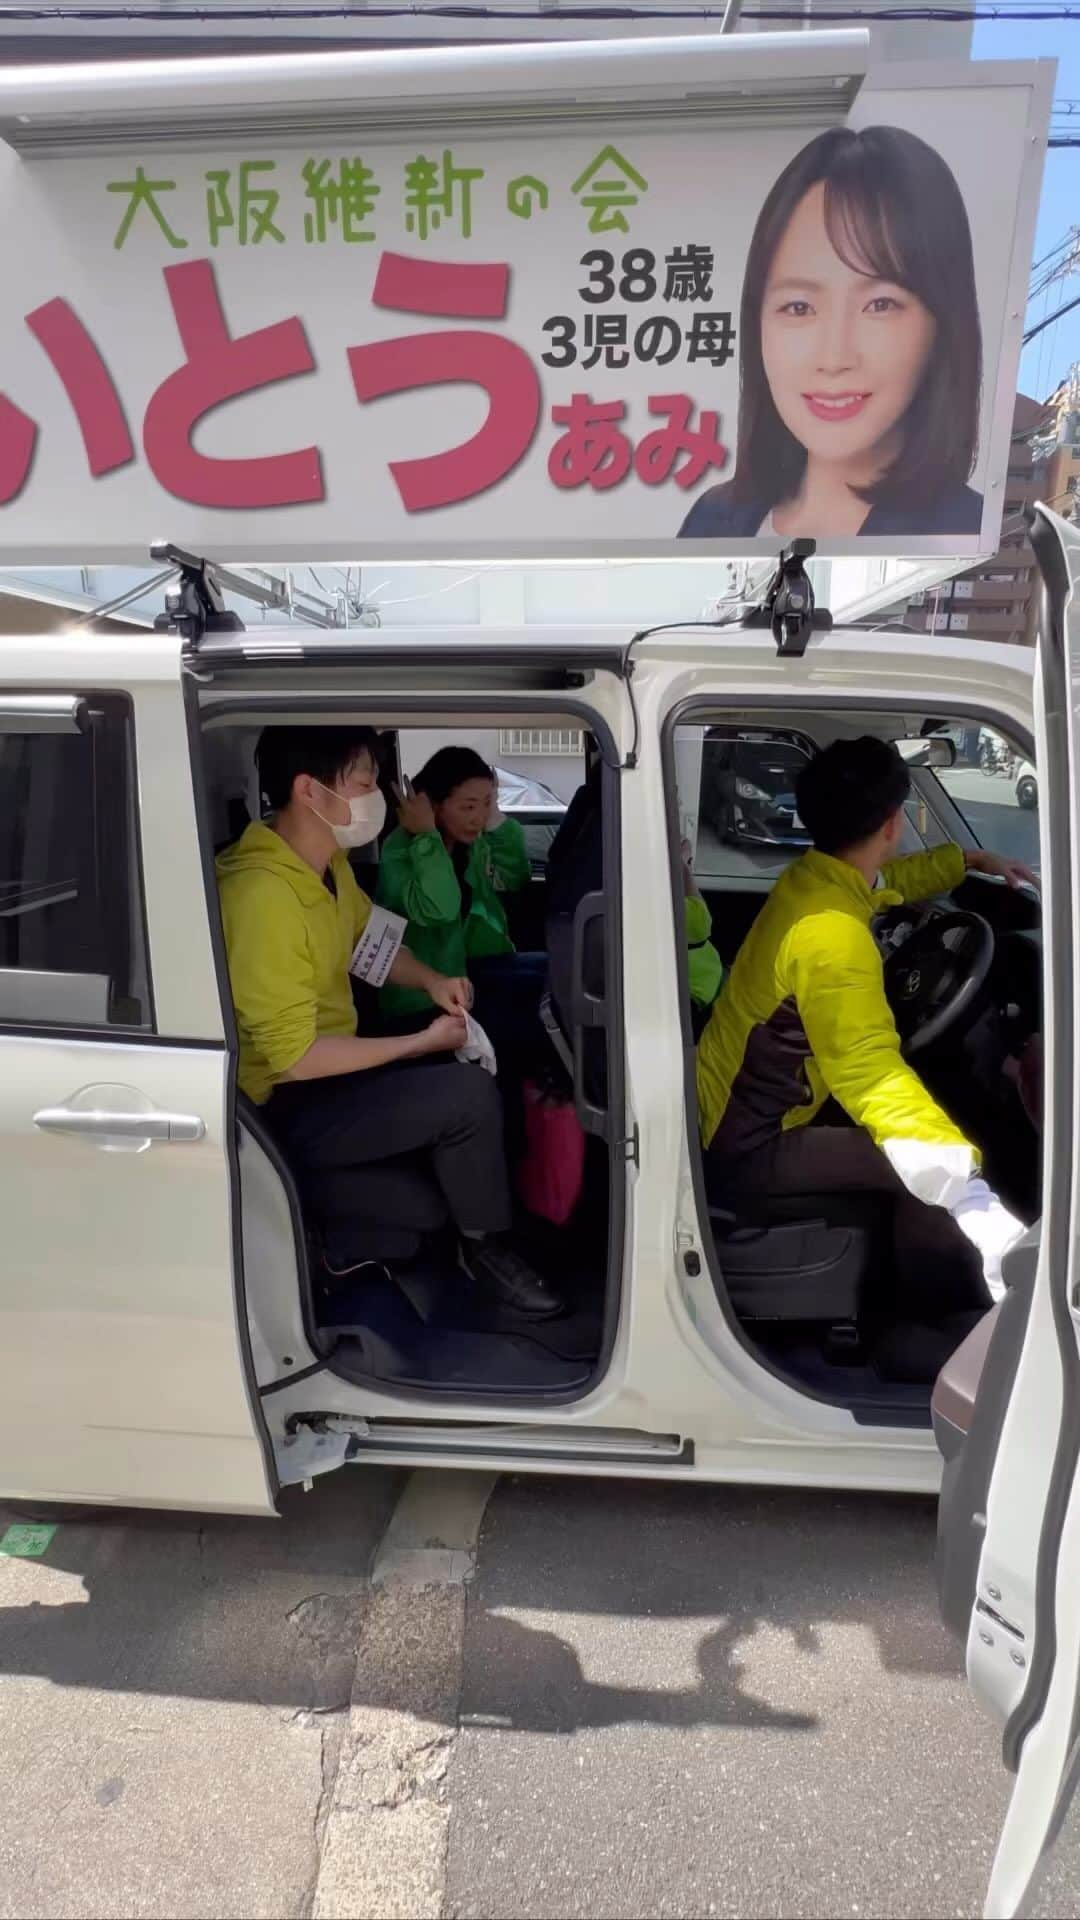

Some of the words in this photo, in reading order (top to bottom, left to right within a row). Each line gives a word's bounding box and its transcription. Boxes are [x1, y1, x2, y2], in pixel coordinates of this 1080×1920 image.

[106, 145, 649, 251] 大阪維新の会
[579, 245, 713, 303] 38歳
[542, 312, 736, 369] 3児の母
[548, 393, 728, 490] あみ
